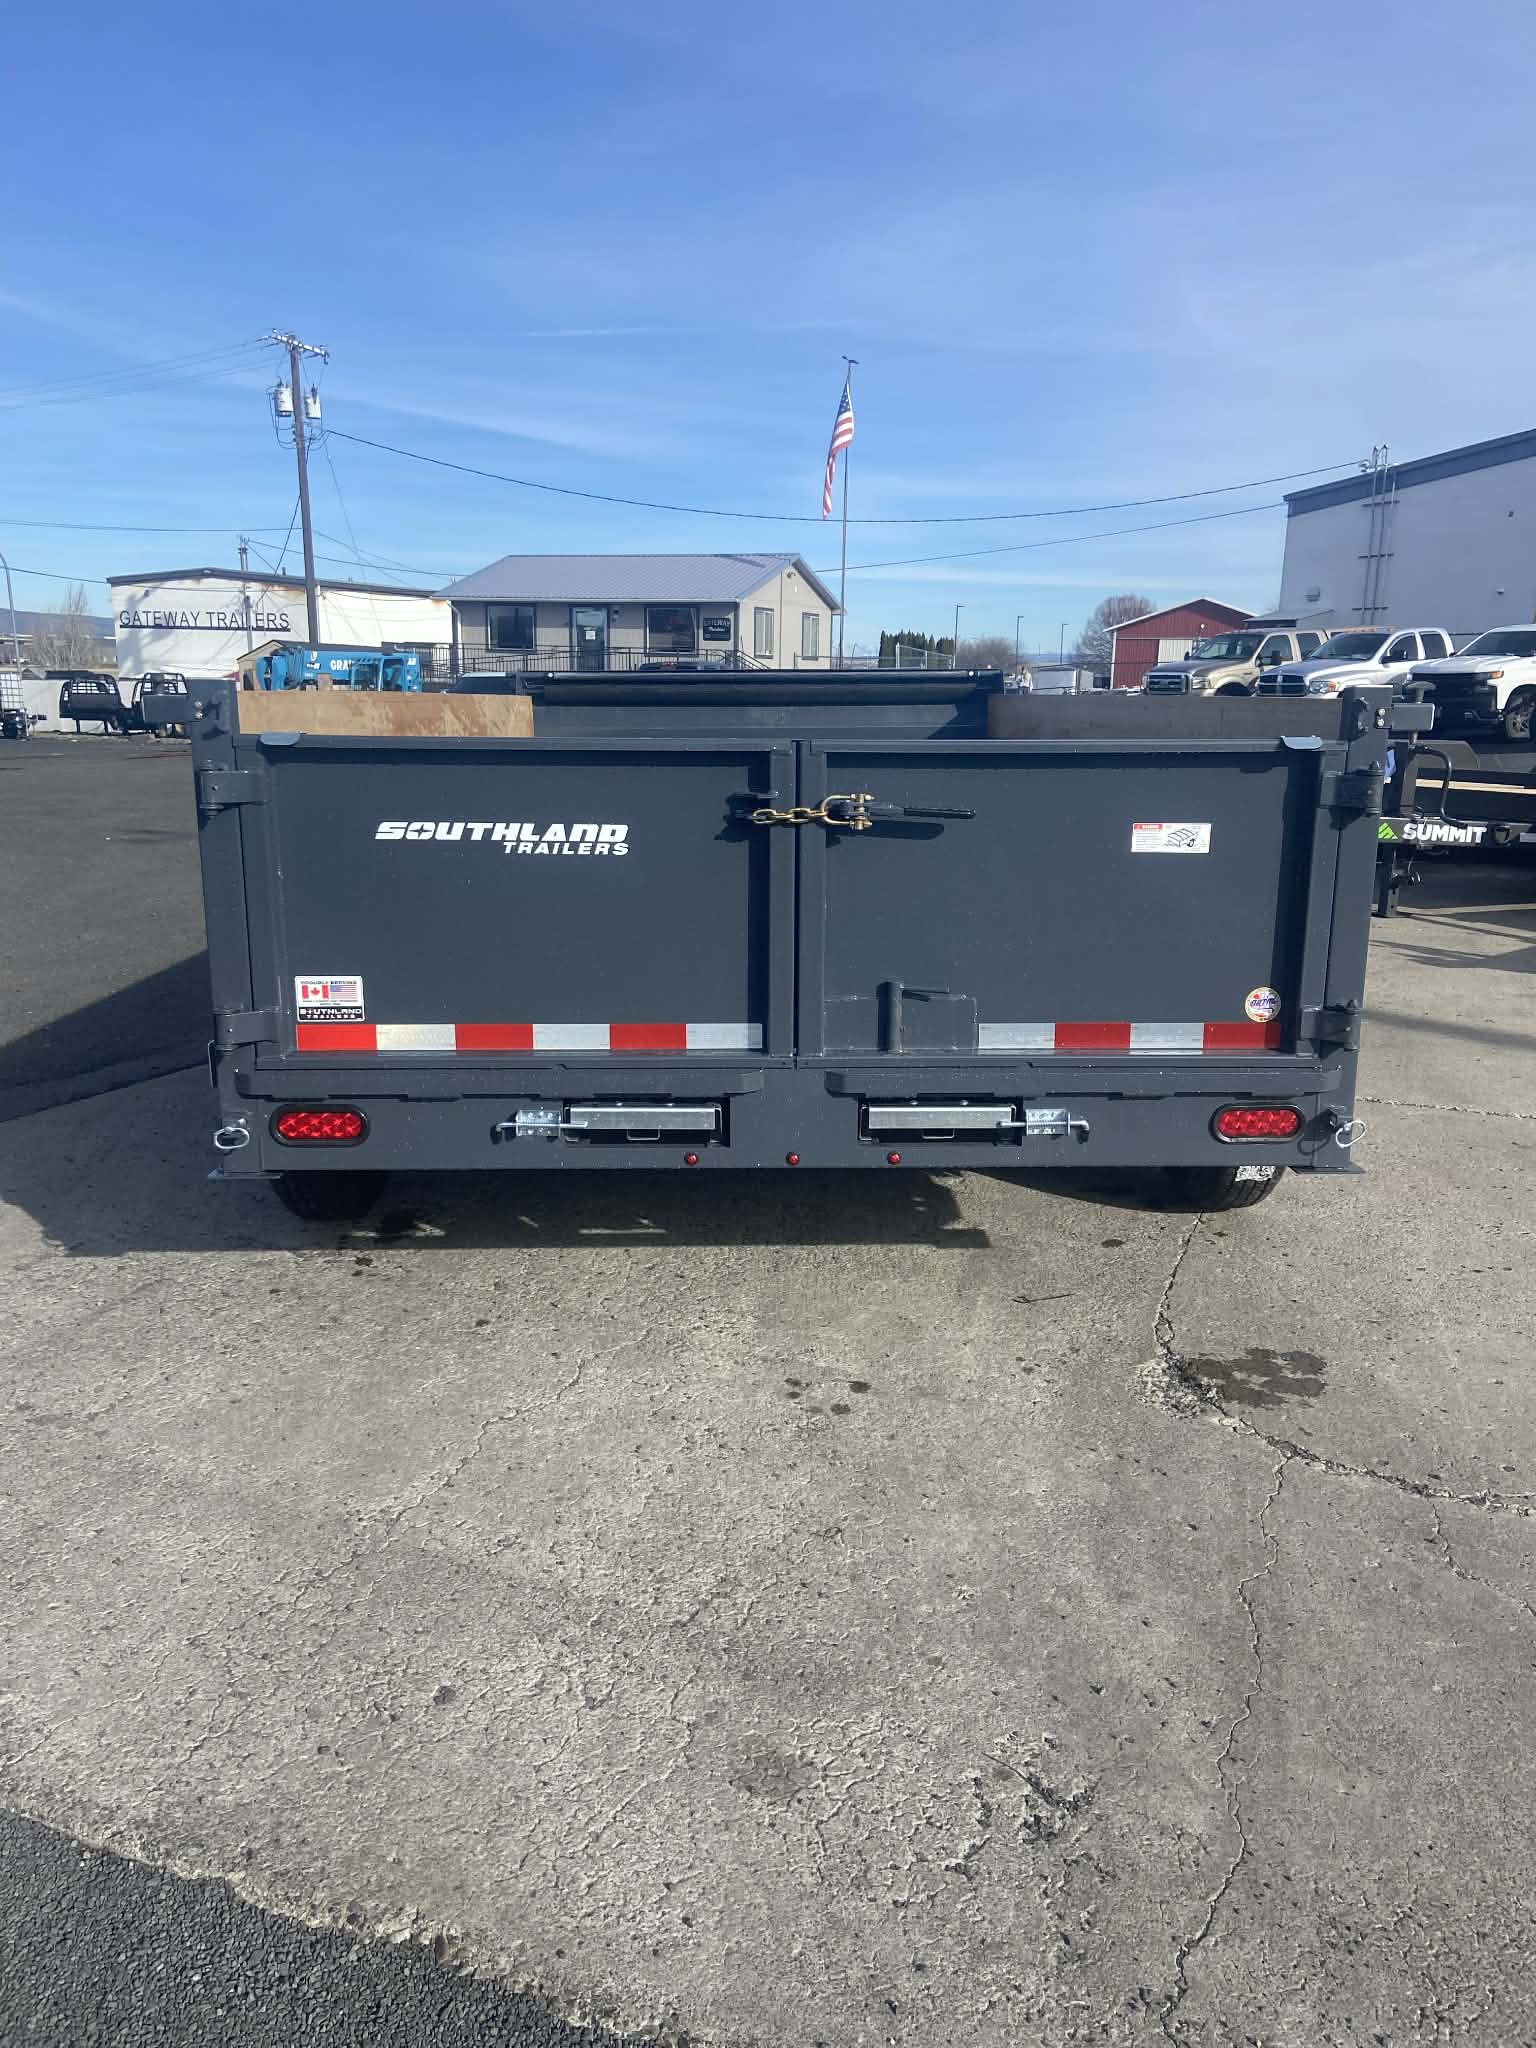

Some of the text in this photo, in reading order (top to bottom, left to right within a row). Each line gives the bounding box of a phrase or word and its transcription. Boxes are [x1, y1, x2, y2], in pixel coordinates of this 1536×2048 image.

[119, 610, 289, 628] GATEWAY TRAILERS
[330, 659, 352, 671] GRA
[375, 821, 629, 842] SOUTHLAND
[1402, 823, 1488, 843] SUMMIT
[503, 841, 629, 856] TRAILERS
